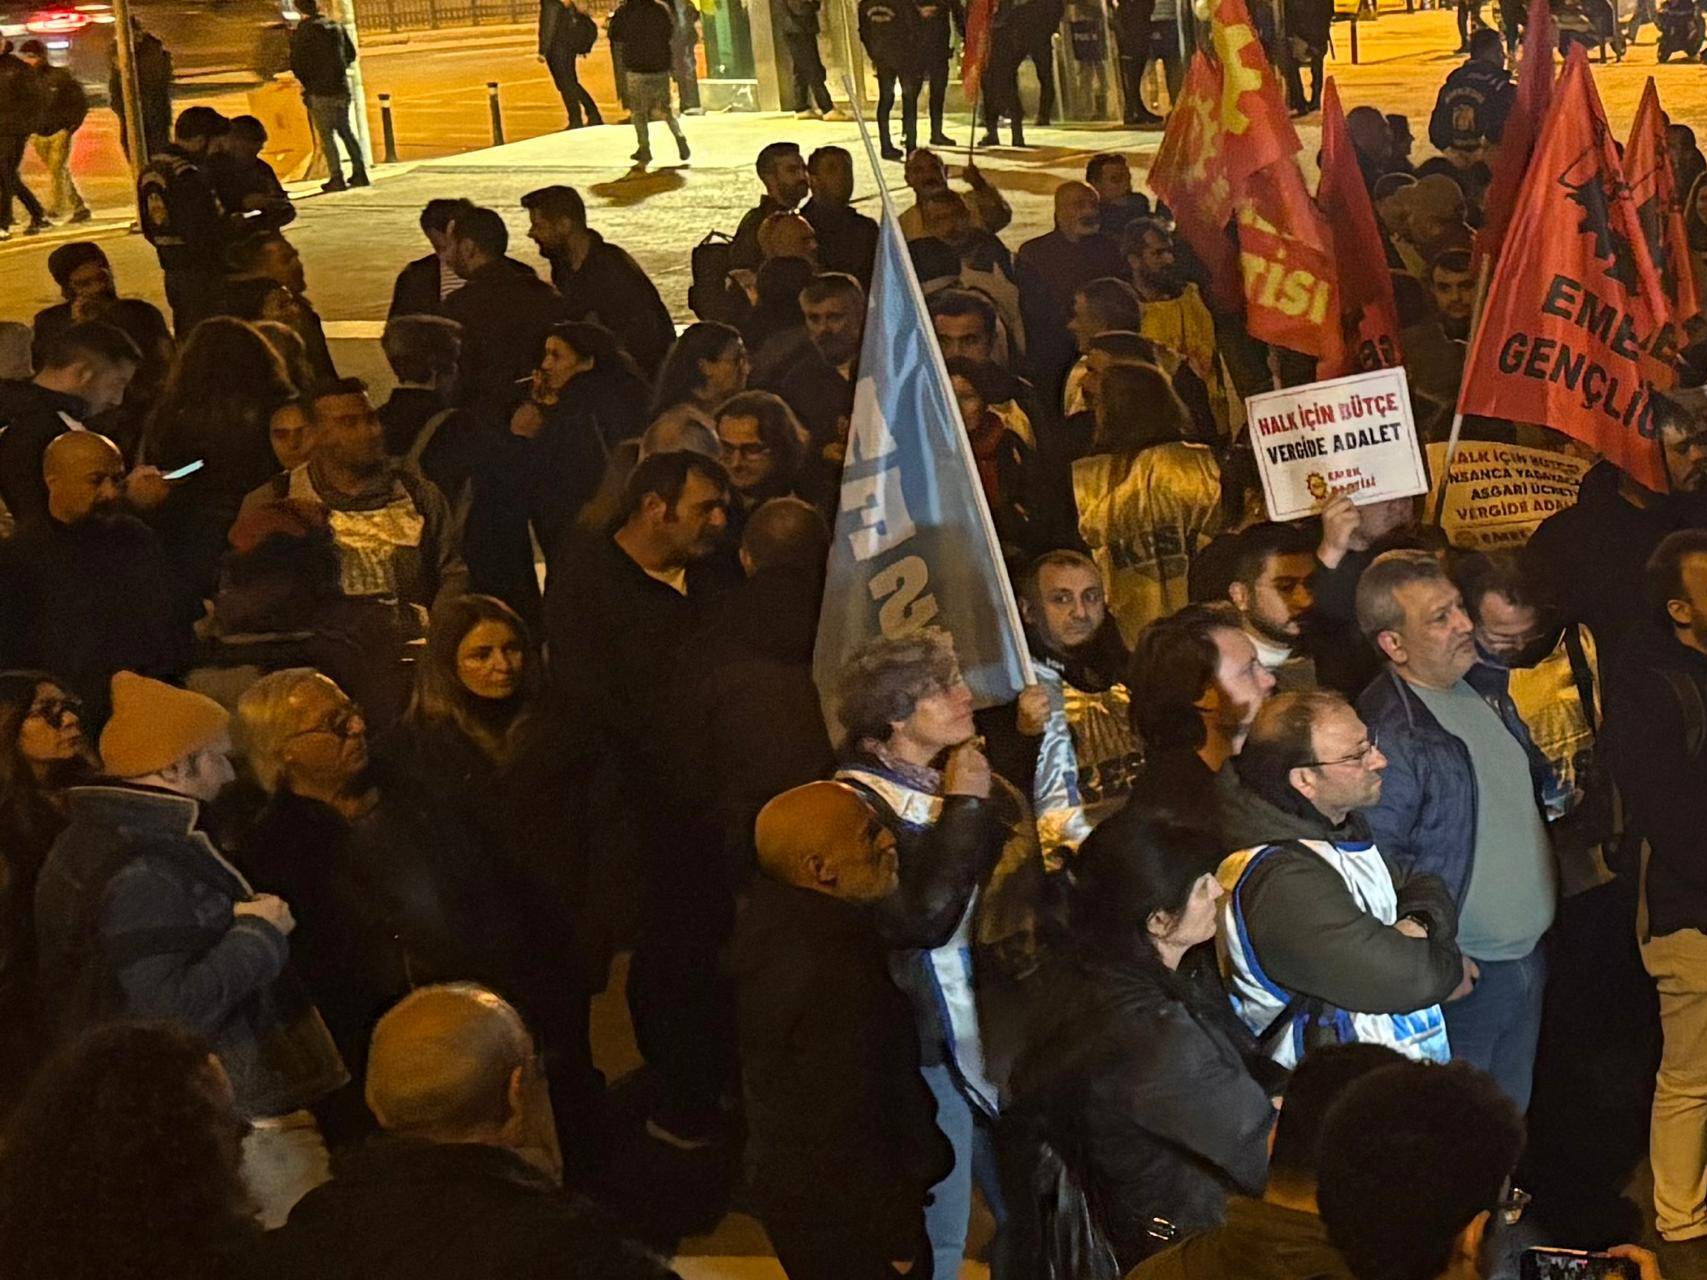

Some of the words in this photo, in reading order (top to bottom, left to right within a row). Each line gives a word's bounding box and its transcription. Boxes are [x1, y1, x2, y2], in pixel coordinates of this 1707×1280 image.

[1258, 408, 1301, 436] HALK
[1298, 401, 1336, 431] İÇİN
[1338, 393, 1398, 421] BÜTÇE
[1266, 435, 1329, 465] VERGİDE
[1332, 422, 1403, 453] ADALET
[1450, 450, 1489, 465] ALK
[1449, 468, 1512, 485] NSANCA
